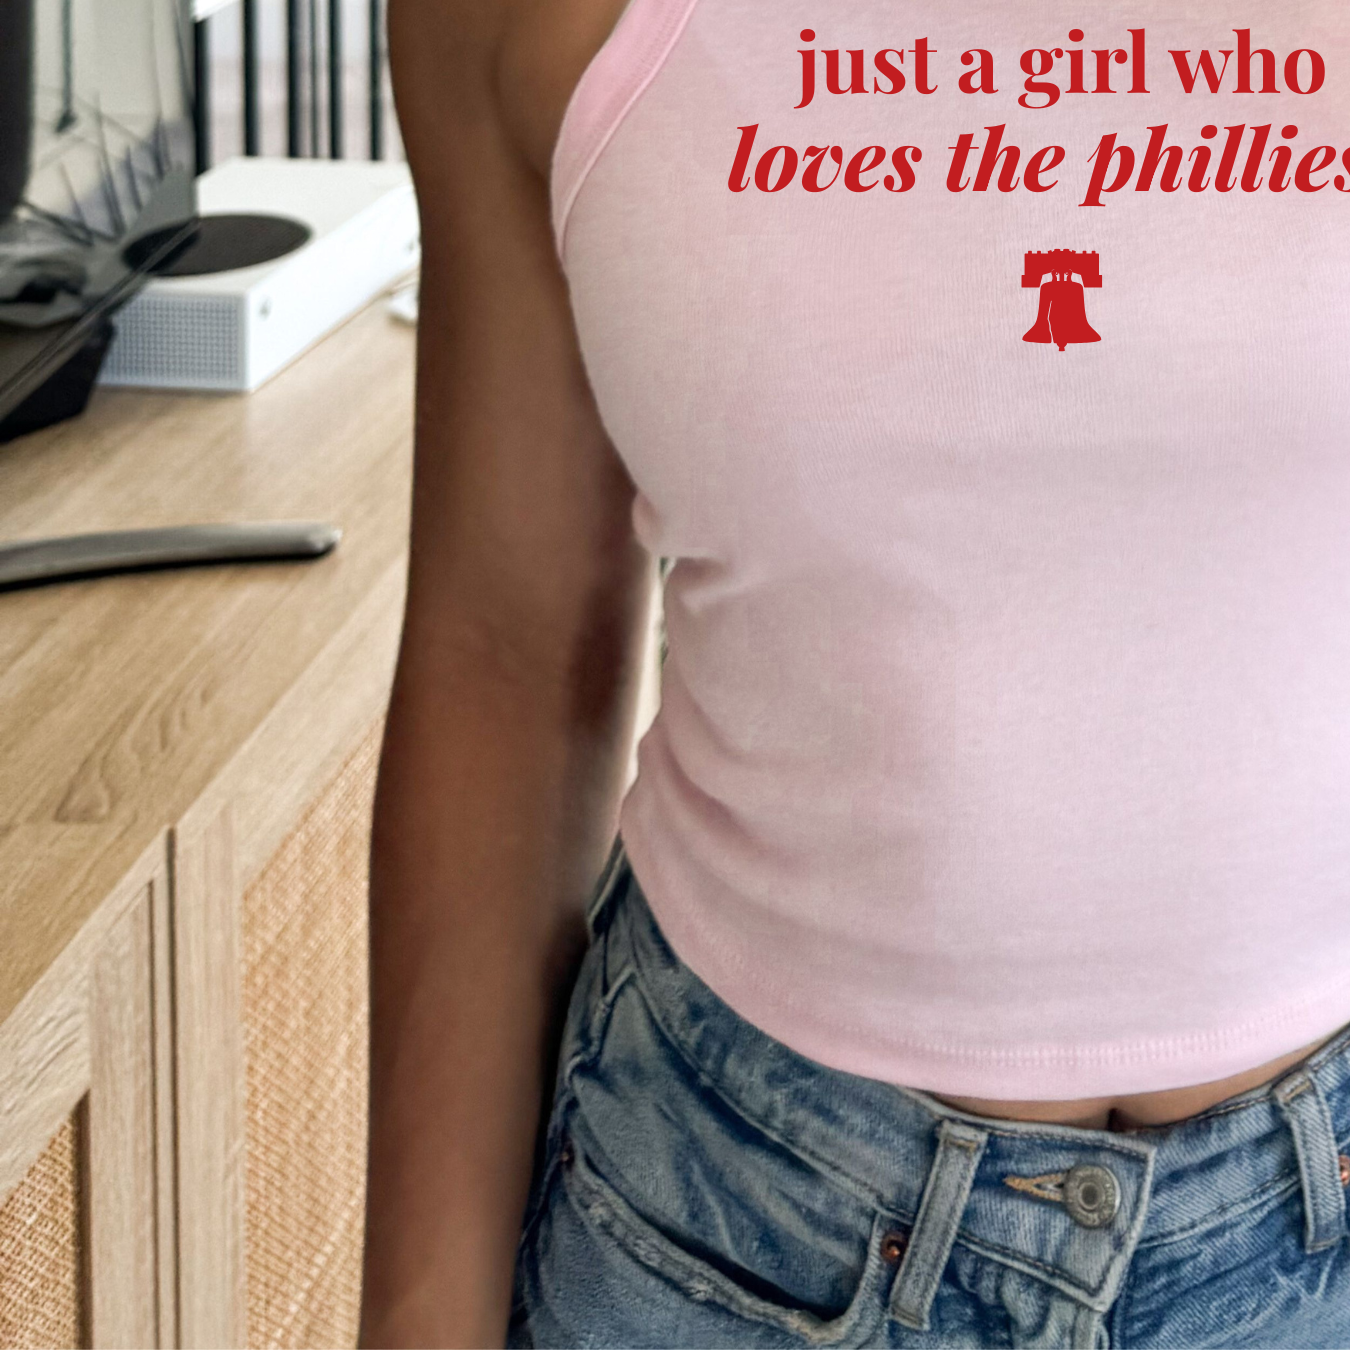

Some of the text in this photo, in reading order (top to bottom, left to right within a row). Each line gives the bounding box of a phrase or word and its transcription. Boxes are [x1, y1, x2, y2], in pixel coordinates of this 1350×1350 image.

[794, 28, 1325, 109] just a girl who
[727, 123, 922, 192] loves
[946, 123, 1065, 192] the
